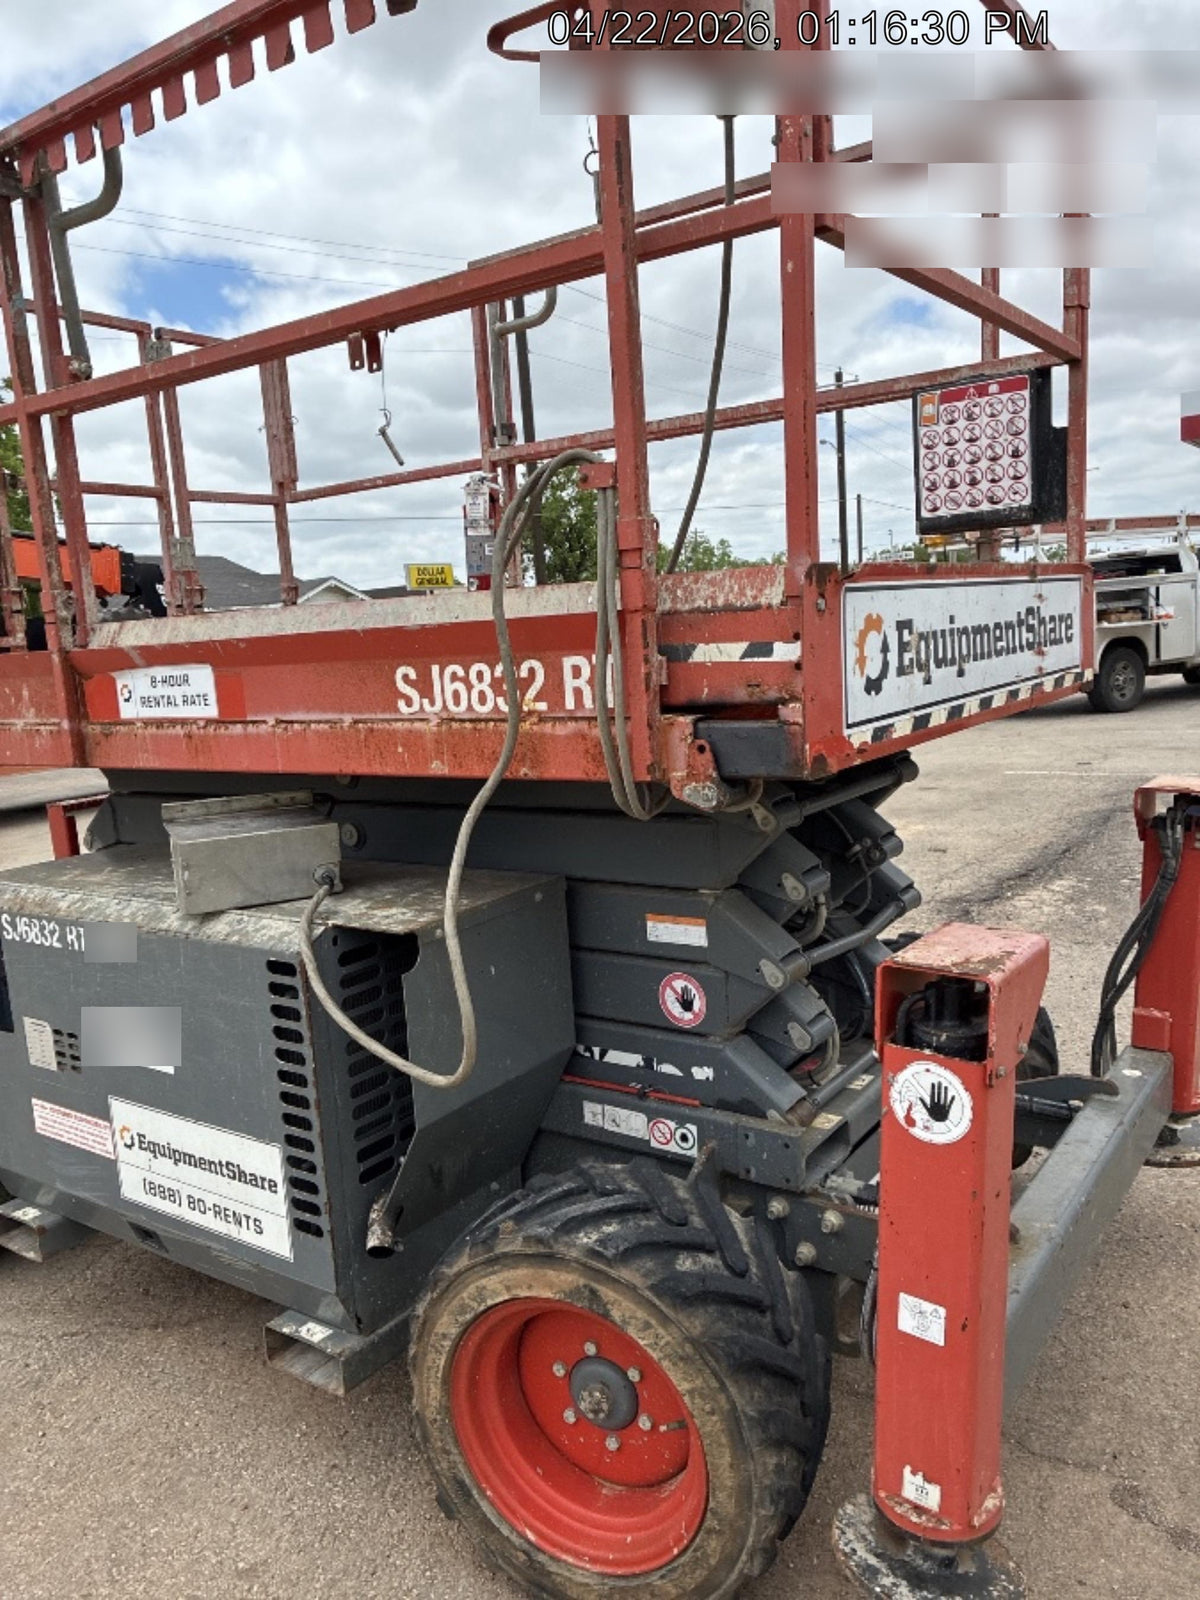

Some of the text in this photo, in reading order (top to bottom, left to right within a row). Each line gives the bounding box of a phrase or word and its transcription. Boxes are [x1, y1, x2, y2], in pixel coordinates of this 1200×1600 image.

[895, 606, 1073, 686] EquipmentShare
[140, 693, 210, 708] RENTAL RATE
[1, 913, 62, 948] SJ6832
[137, 1132, 278, 1194] EquipmentShare
[143, 1177, 264, 1235] (888) 80-RENTS
